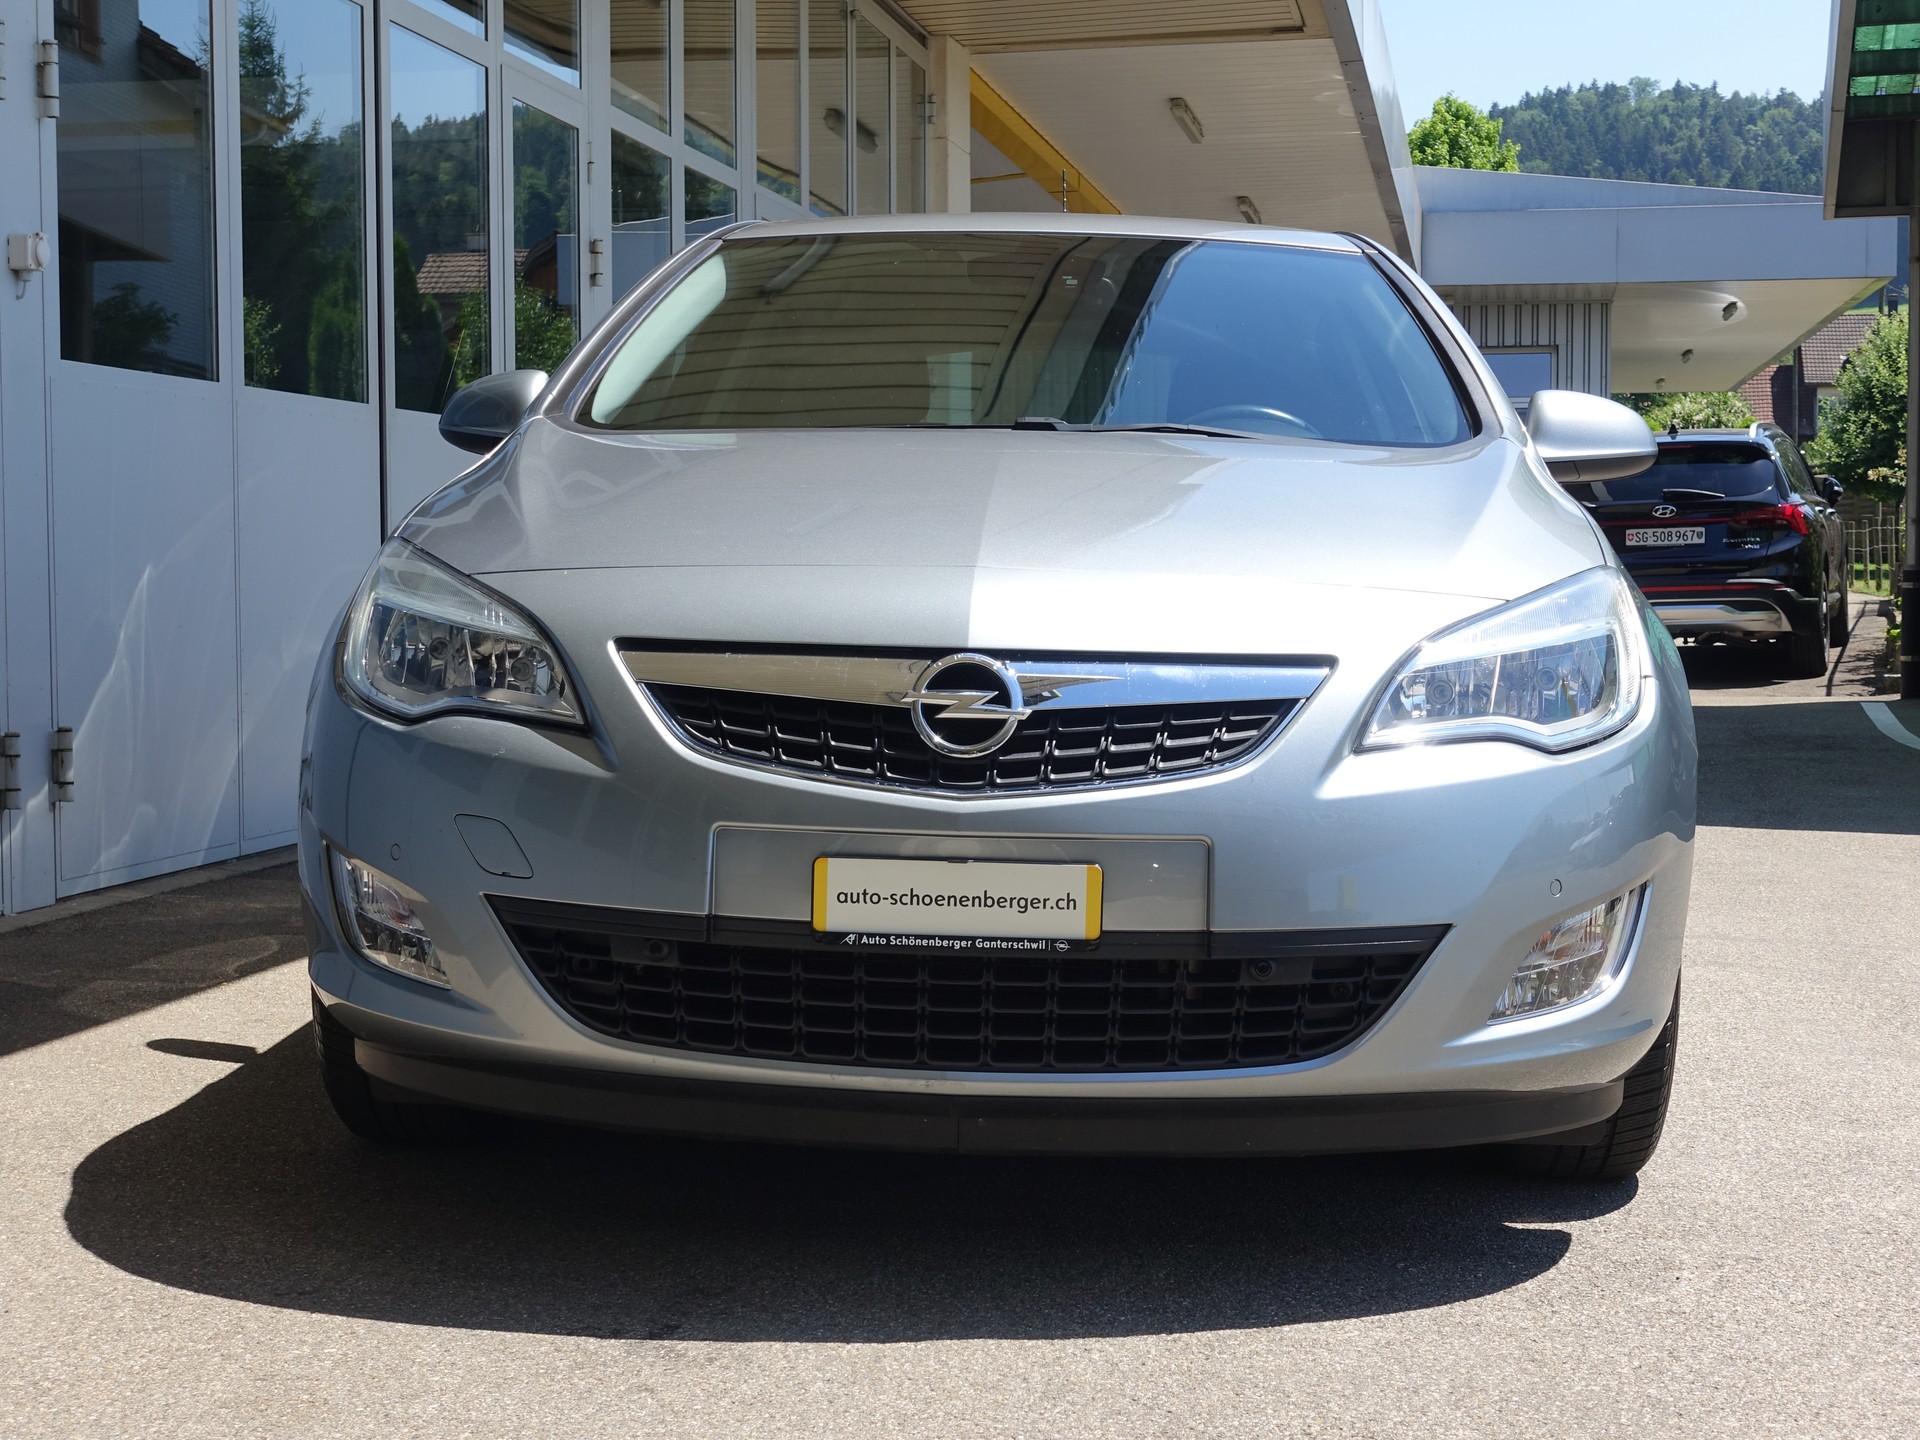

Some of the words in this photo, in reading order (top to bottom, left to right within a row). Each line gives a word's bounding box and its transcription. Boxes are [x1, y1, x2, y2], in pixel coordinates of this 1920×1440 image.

[836, 888, 1077, 913] auto-schoenenberger.ch
[861, 934, 887, 945] Auto
[889, 936, 972, 950] Schönenberger
[975, 939, 1046, 951] Ganterschwil
